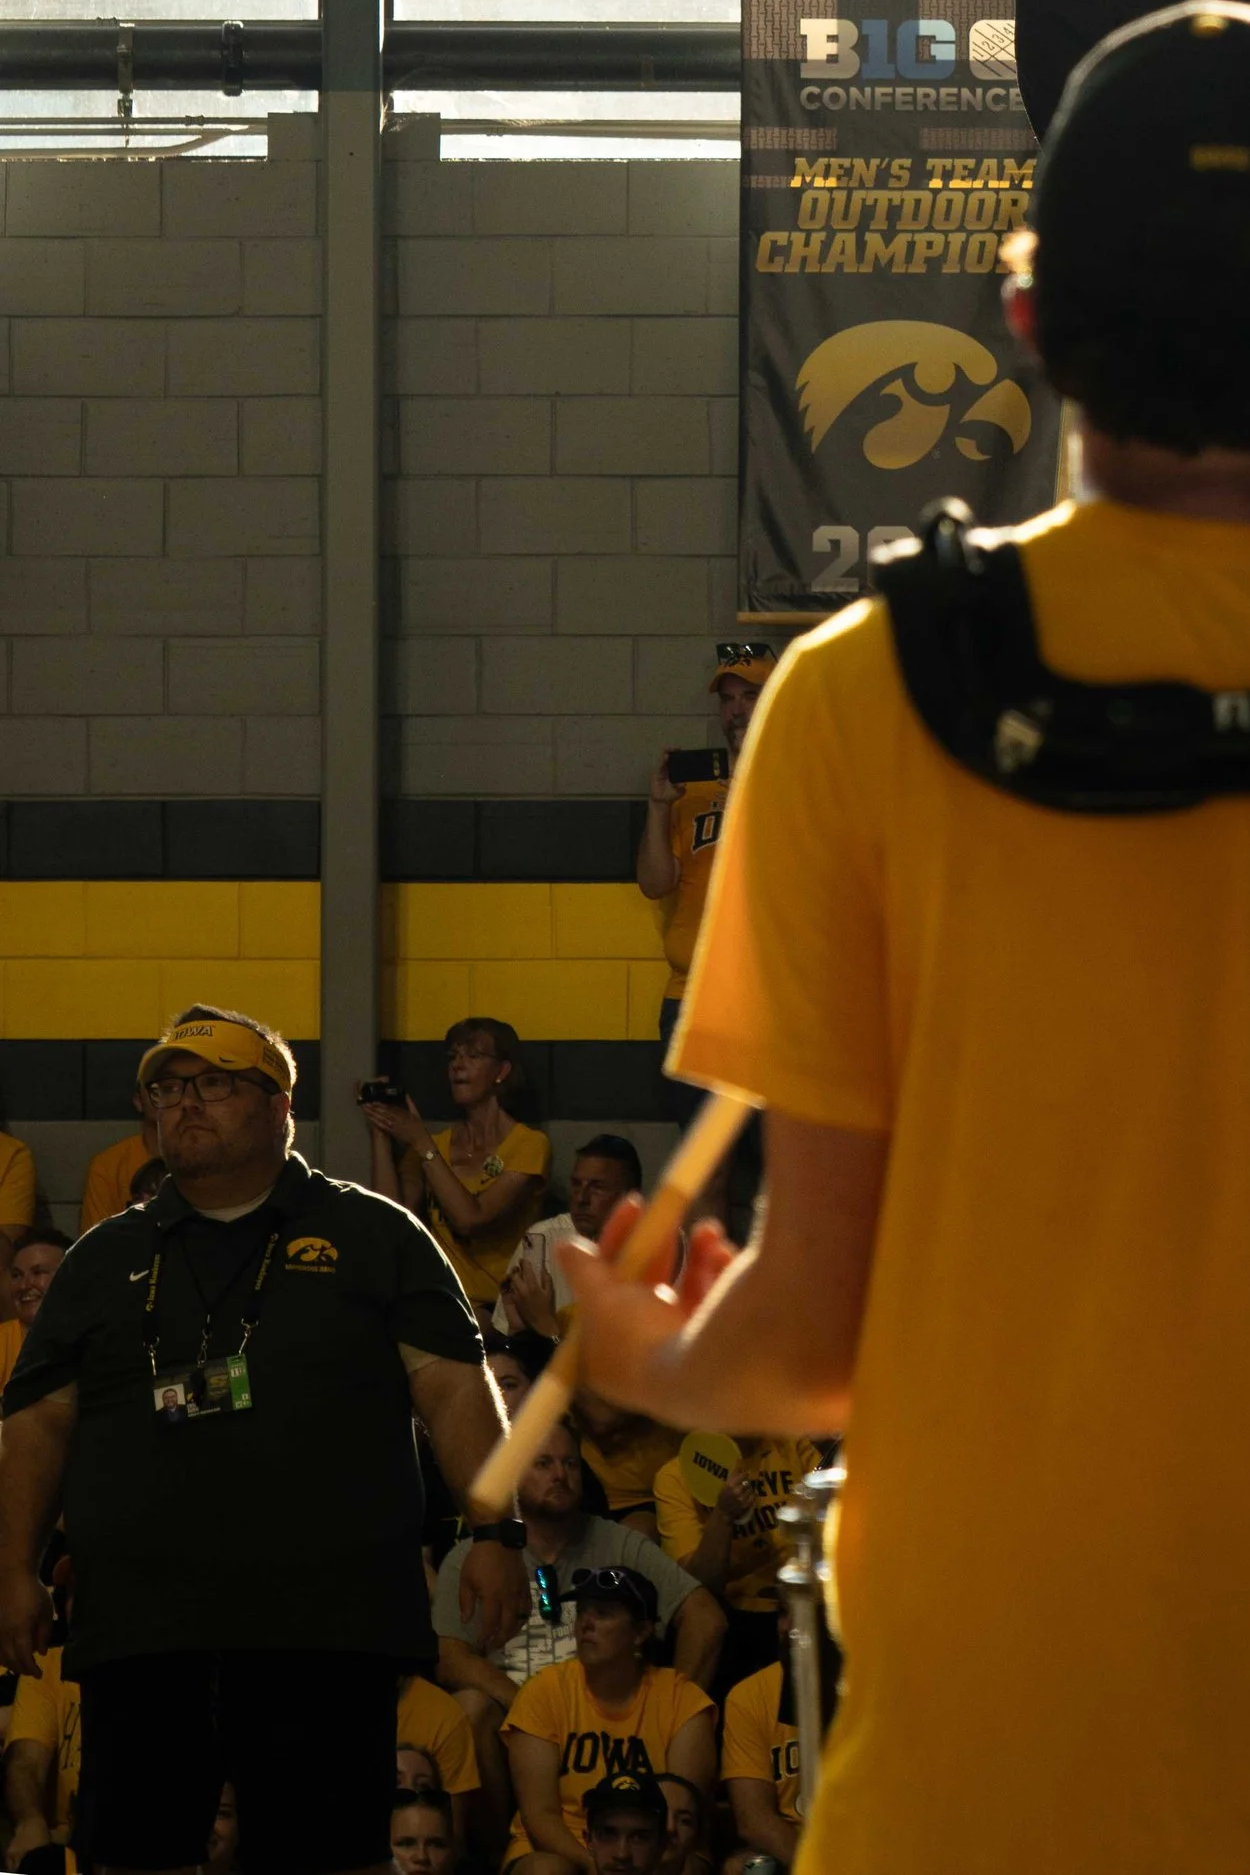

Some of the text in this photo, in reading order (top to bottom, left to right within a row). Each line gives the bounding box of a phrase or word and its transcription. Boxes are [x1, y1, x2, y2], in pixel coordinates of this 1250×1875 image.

[801, 86, 1026, 111] CONFERENCE
[790, 158, 1037, 188] MEN'S TEAM
[797, 190, 1030, 230] OUTDOOR
[755, 231, 1012, 273] CHAMPIO
[693, 1451, 729, 1482] IOWA
[560, 1731, 654, 1778] IOWA
